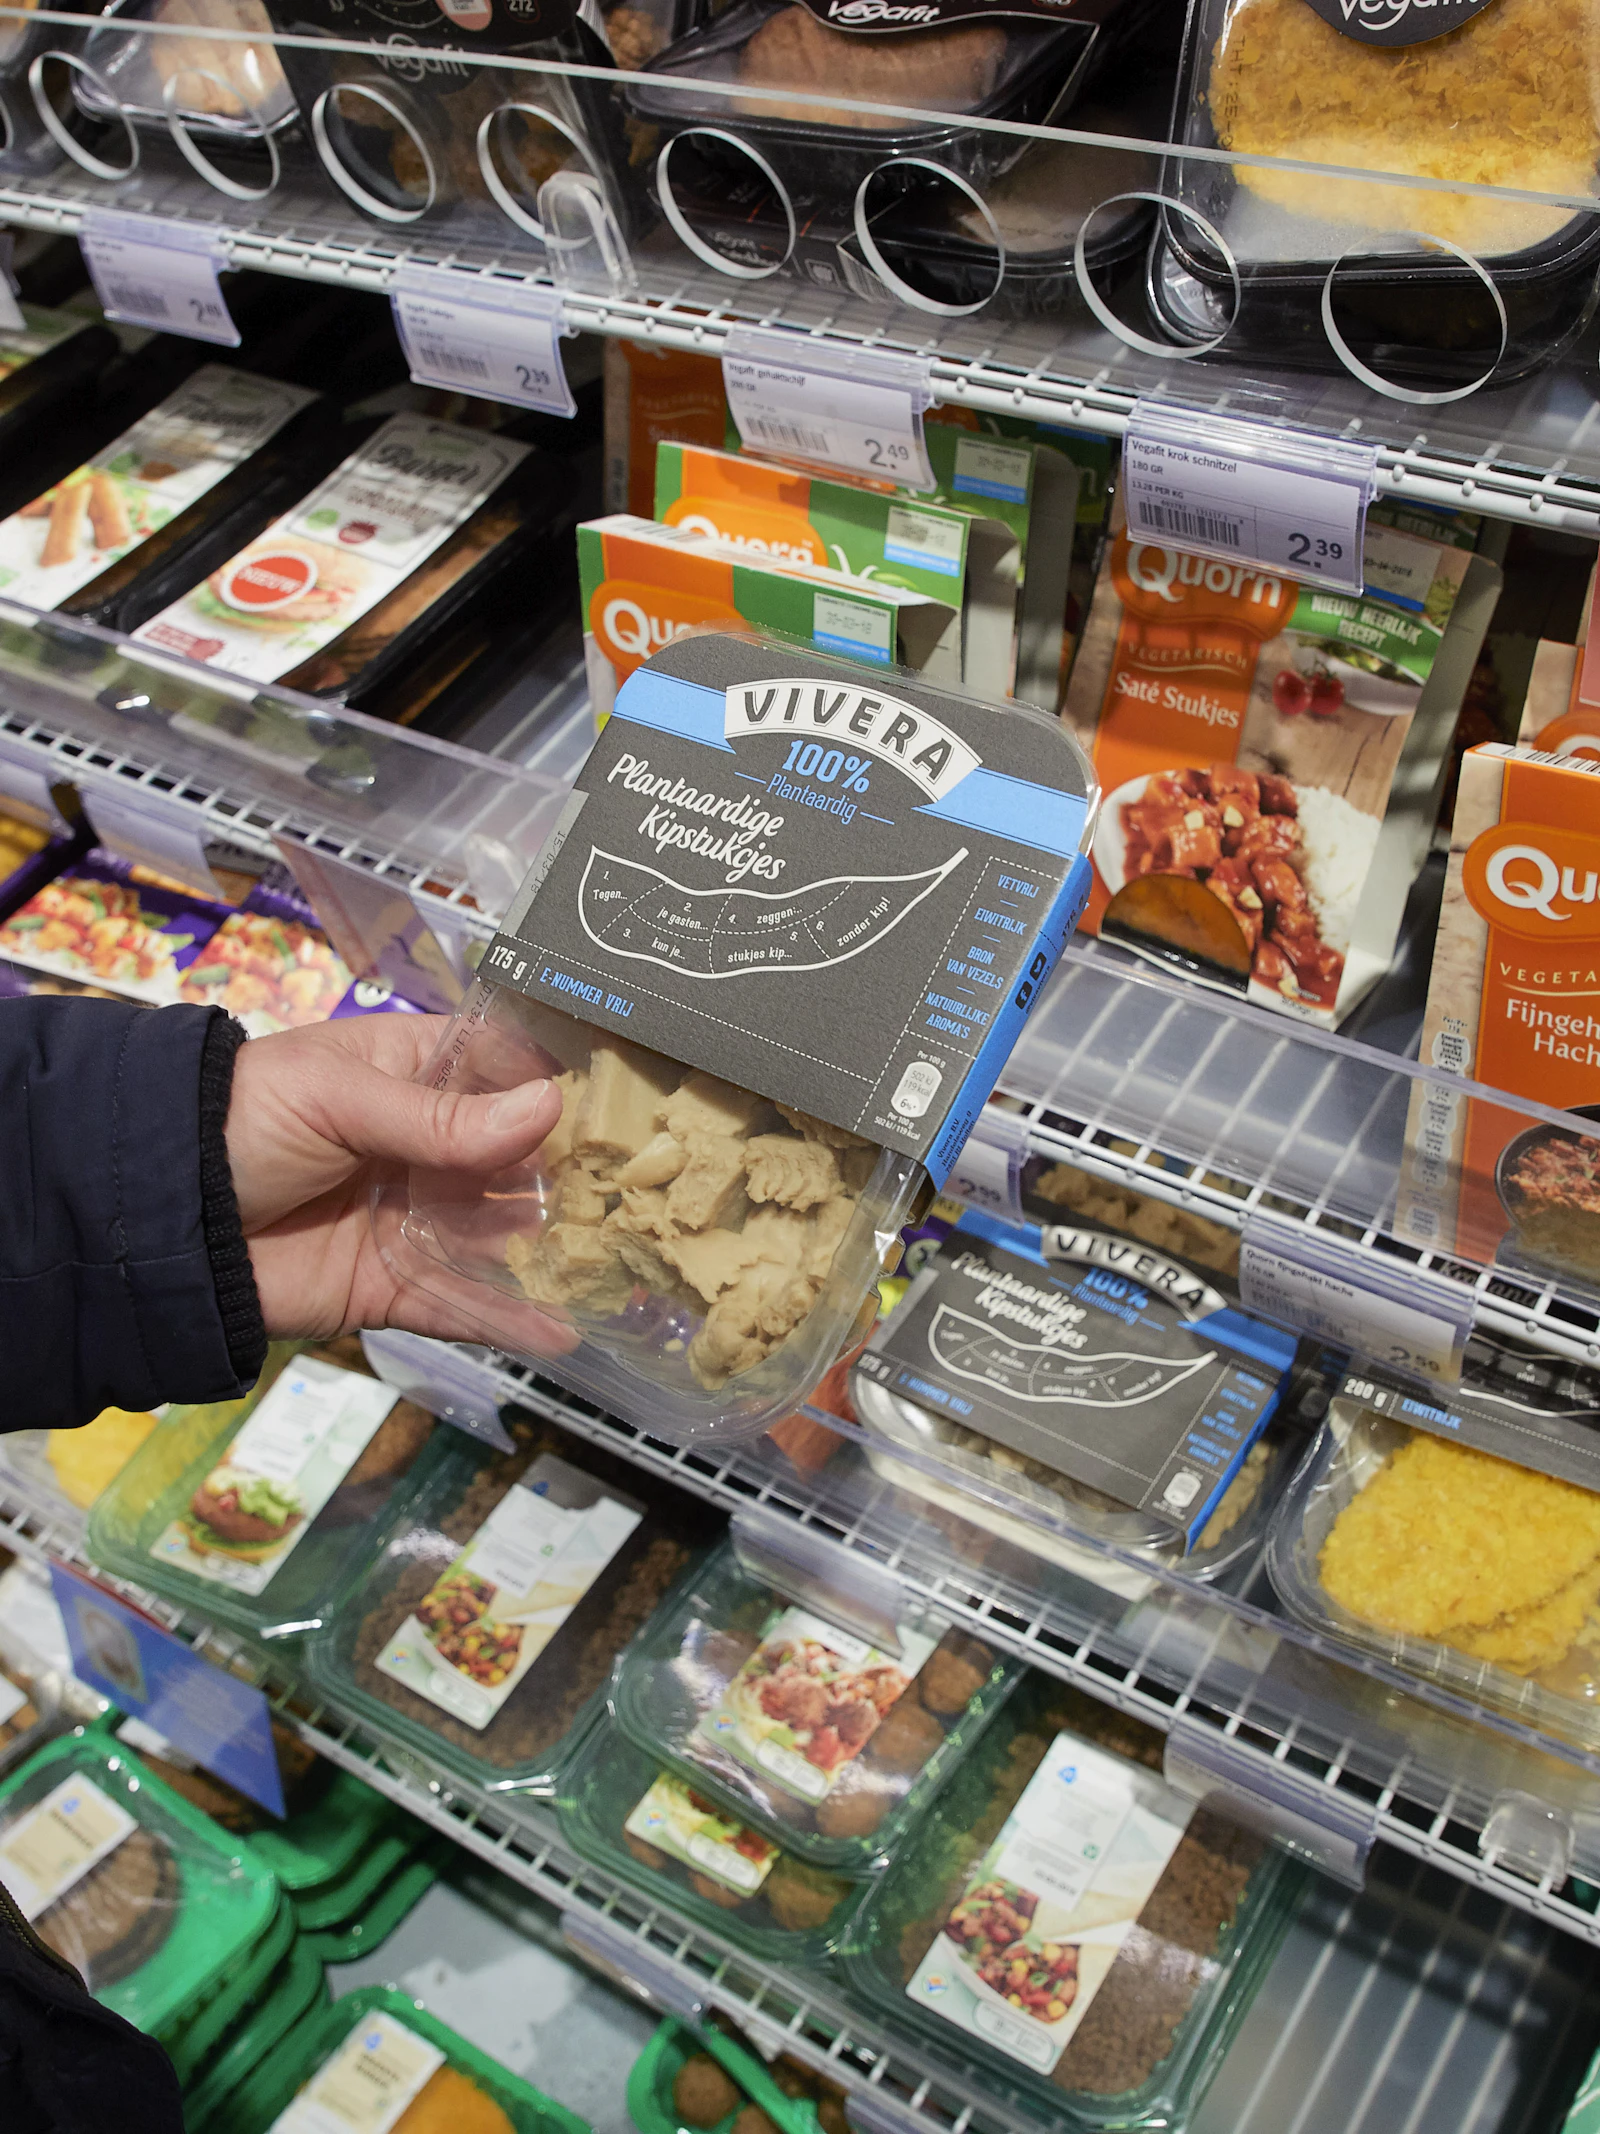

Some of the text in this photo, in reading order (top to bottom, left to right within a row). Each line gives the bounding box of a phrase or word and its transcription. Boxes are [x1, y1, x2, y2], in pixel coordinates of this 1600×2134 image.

[828, 0, 941, 24] Vegafit
[864, 438, 909, 470] 2.49
[1132, 441, 1237, 473] Vegafit krok schnitzel
[1132, 460, 1163, 475] 180 GR
[1154, 486, 1170, 496] PER
[1172, 488, 1184, 499] KG
[1287, 532, 1343, 568] 2.39
[1126, 543, 1283, 608] Quorn
[1311, 594, 1424, 647] NIEUW HEERLIJK
[1338, 620, 1389, 649] RECEPT
[1127, 642, 1248, 670] VEGETARISCH
[1114, 671, 1240, 729] Saté Stukjes
[743, 686, 956, 786] VIVERA
[781, 739, 874, 794] 100%
[607, 752, 785, 839] Plantaardige
[765, 771, 858, 826] Plantaardig
[593, 889, 628, 902] Tegen...
[997, 874, 1040, 898] VETVRIJ
[656, 906, 709, 931] je gasten...
[683, 902, 692, 912] 2.
[728, 914, 736, 924] 4.
[837, 896, 891, 947] zonder kip!
[974, 907, 1028, 936] EIWITRIJK
[623, 928, 631, 939] 3.
[789, 931, 798, 942] 5.
[815, 920, 825, 932] 6.
[488, 945, 528, 980] 175 g
[651, 936, 686, 960] kun je...
[727, 946, 793, 964] stukjes kip...
[967, 945, 996, 965] BRON
[946, 958, 1005, 990] VAN VEZELS
[467, 984, 492, 1025] 07:34
[540, 967, 635, 1018] E-NUMMER VRIJ
[924, 991, 990, 1026] NATUURLIJKE
[925, 1012, 971, 1039] AROMA'S
[917, 1050, 946, 1069] Per 100 g
[903, 1079, 933, 1097] 119 kcal
[910, 1070, 925, 1082] 502
[874, 1115, 886, 1125] 502
[895, 1123, 908, 1135] 119
[907, 1127, 921, 1140] kcal
[887, 1111, 915, 1130] Per 100 g
[936, 1133, 954, 1159] Vivera
[1057, 1233, 1206, 1311] VIVERA
[951, 1251, 1087, 1323] Plantaardige
[1083, 1268, 1149, 1309] 100%
[1343, 1378, 1388, 1408] 200 g
[1401, 1397, 1463, 1430] EIWITRIJK
